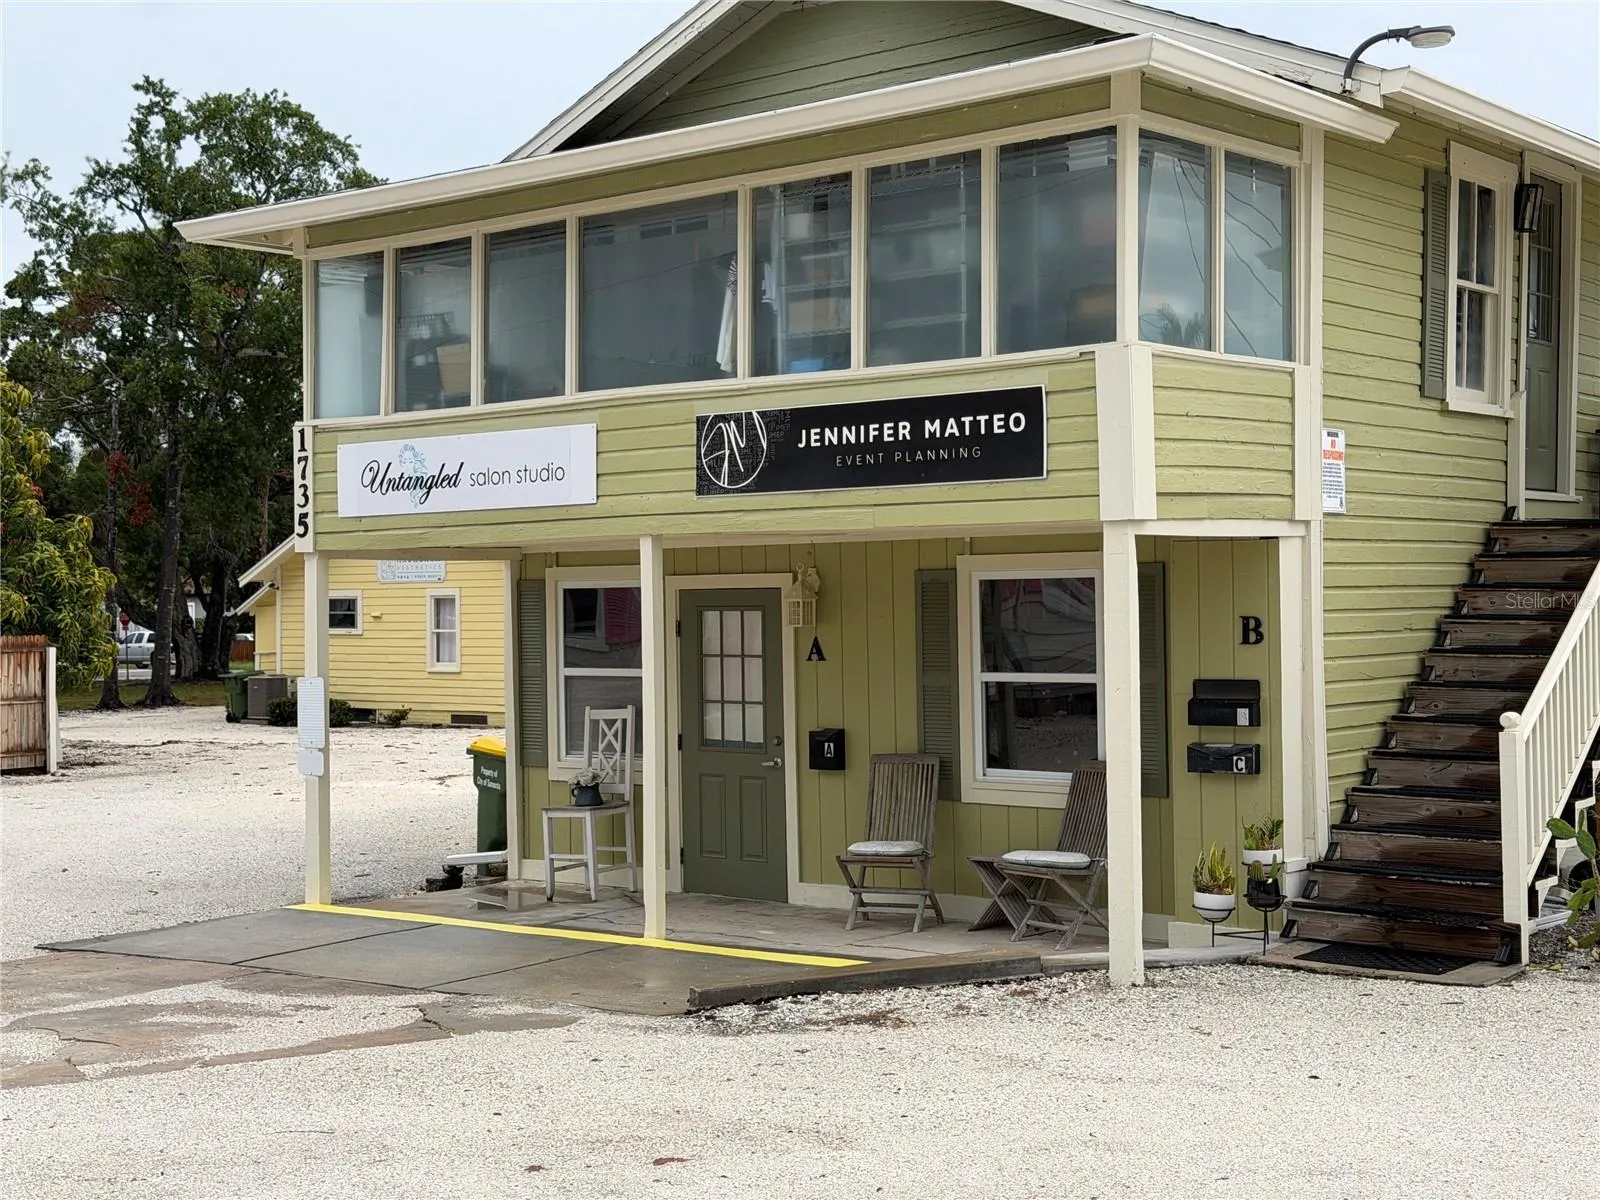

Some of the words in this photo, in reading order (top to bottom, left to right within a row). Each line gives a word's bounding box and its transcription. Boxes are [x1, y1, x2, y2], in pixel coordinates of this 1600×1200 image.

[798, 421, 911, 448] JENNIFER
[924, 412, 1027, 439] MATTEO
[836, 452, 884, 468] EVENT
[895, 446, 982, 463] PLANNING
[296, 427, 310, 538] 1735
[361, 459, 465, 504] Untangled
[469, 467, 511, 488] salon
[516, 462, 566, 484] studio
[1239, 615, 1264, 645] B
[806, 635, 827, 661] A
[825, 743, 833, 756] A
[1235, 757, 1244, 772] C
